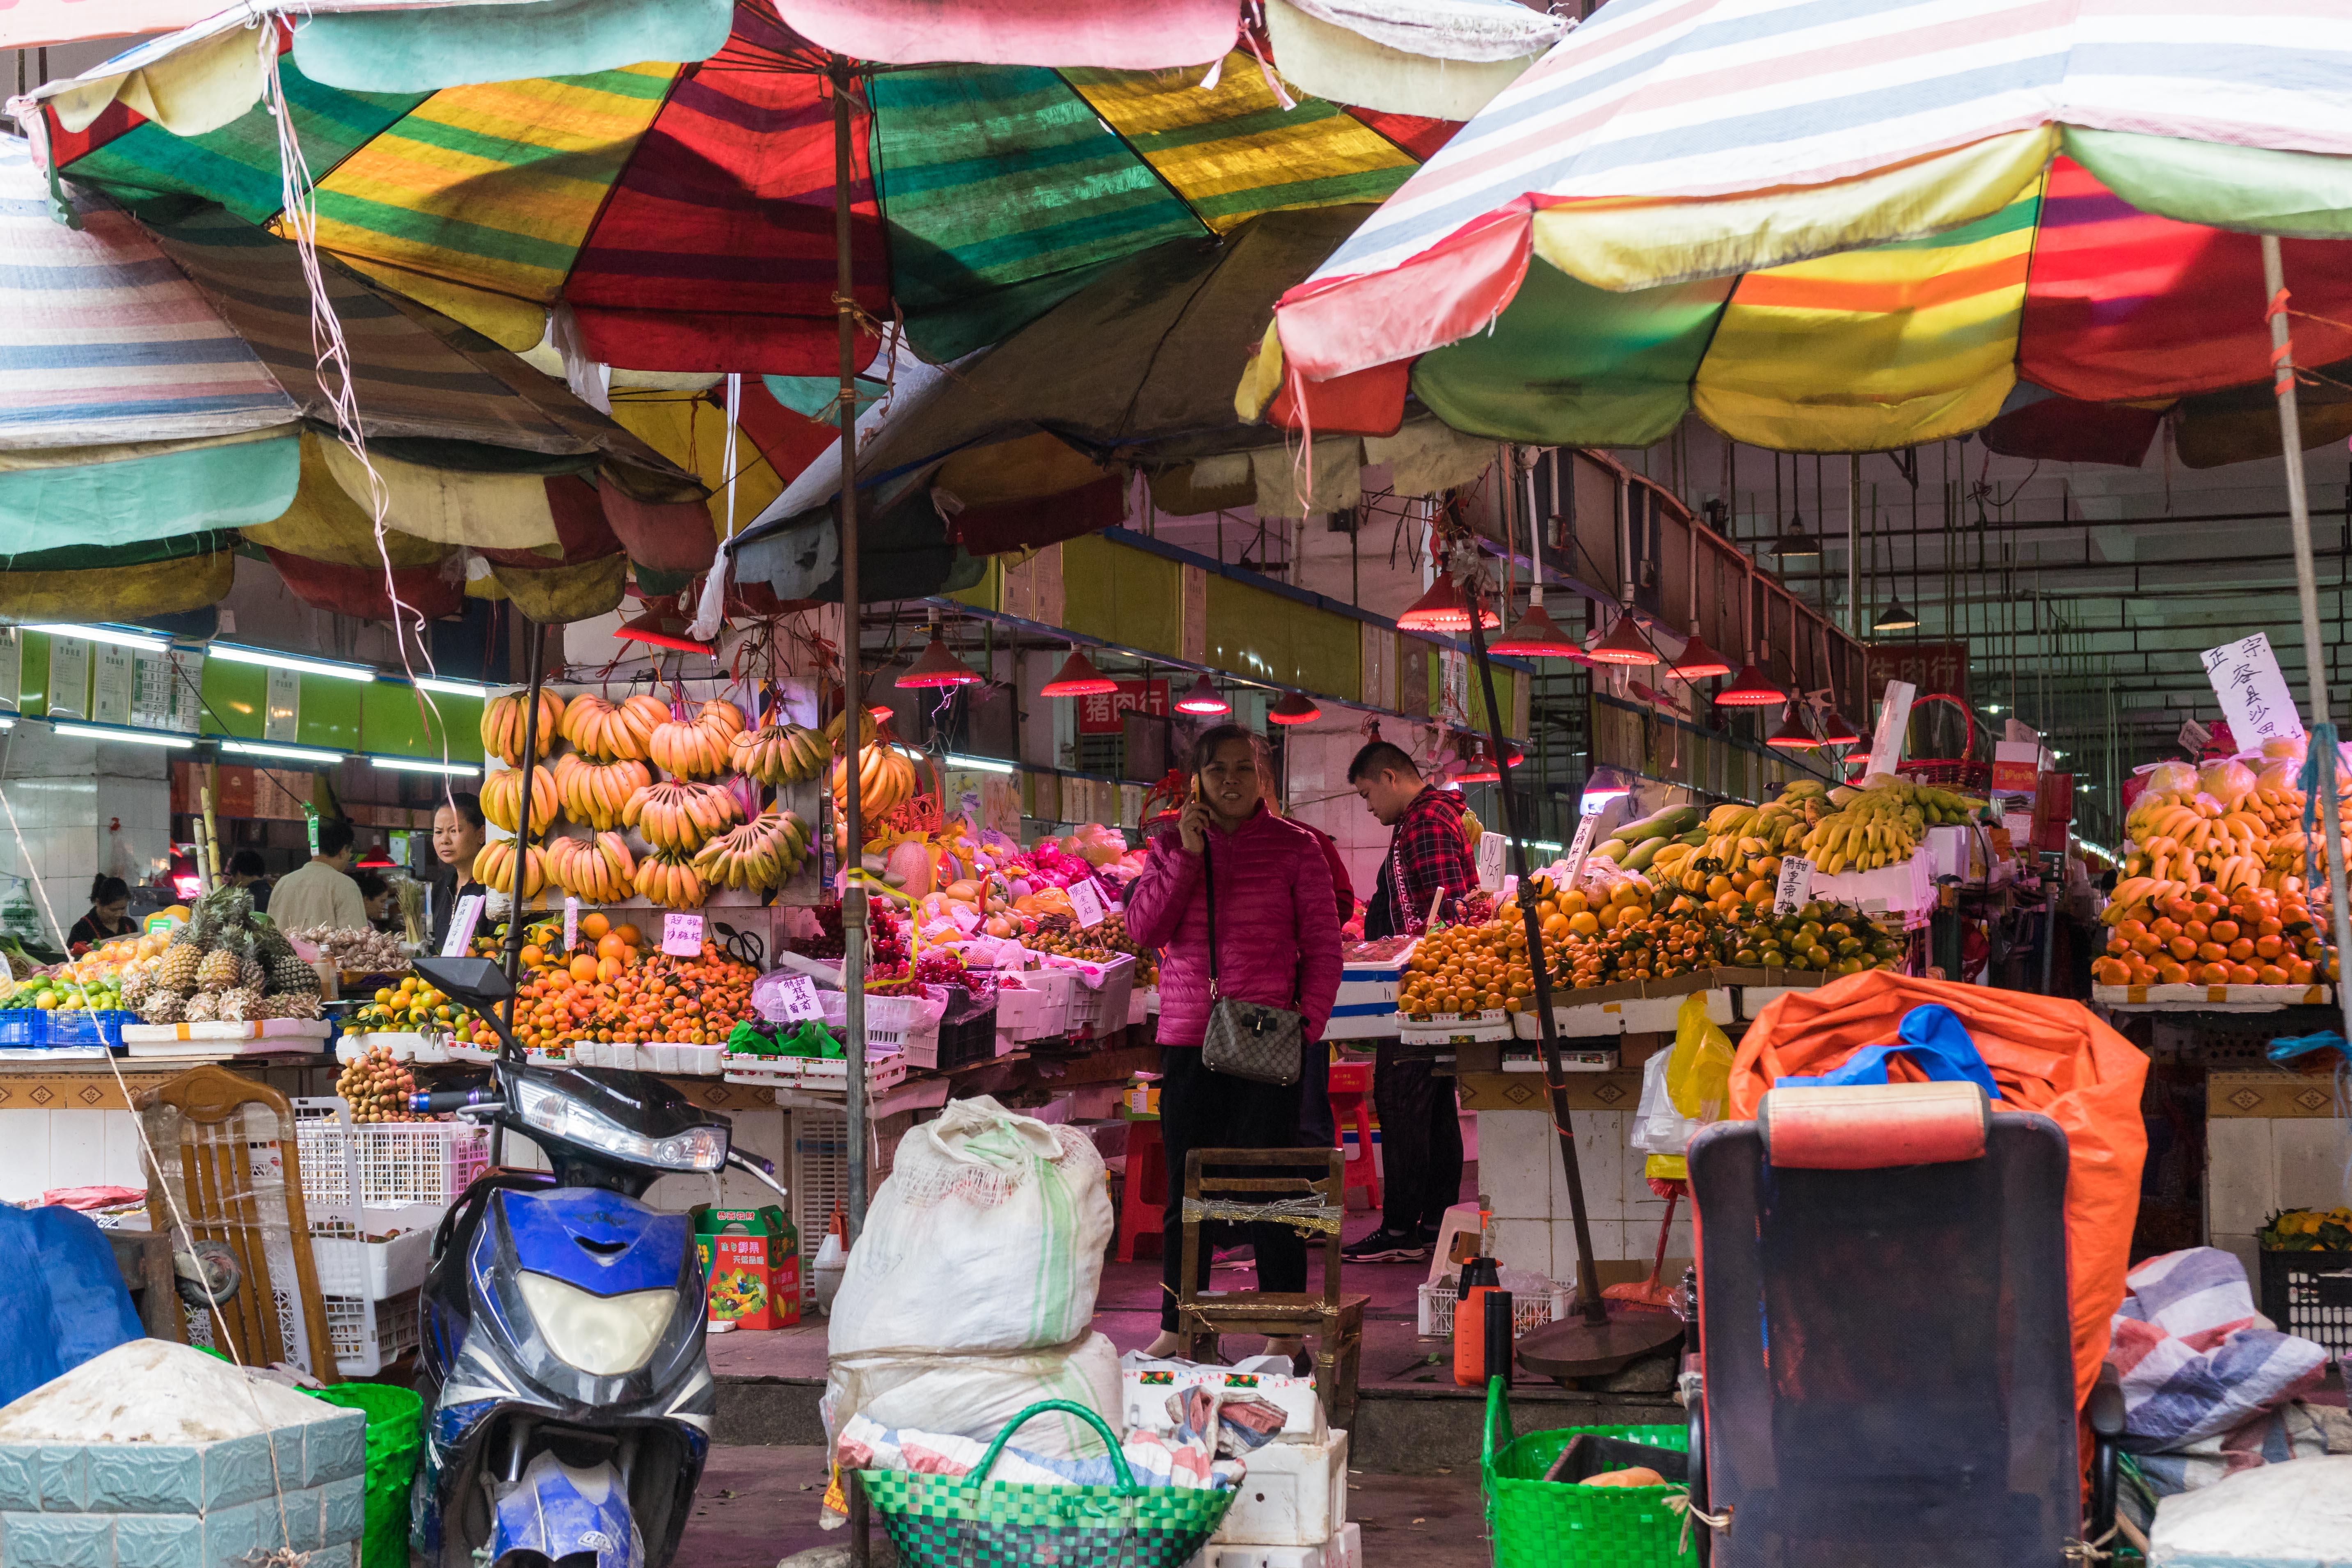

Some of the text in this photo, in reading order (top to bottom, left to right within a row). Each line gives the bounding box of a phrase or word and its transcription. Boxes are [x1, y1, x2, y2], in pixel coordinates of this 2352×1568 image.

[2208, 637, 2265, 675] 正宗
[1870, 657, 1958, 689] 牛肉行
[1086, 691, 1162, 722] 猪肉行
[1785, 858, 1808, 872] 特甜
[1070, 882, 1089, 899] 脆皮
[784, 978, 805, 989] 特甜
[789, 999, 811, 1014] 葡萄
[717, 1211, 755, 1220] 恭喜發財
